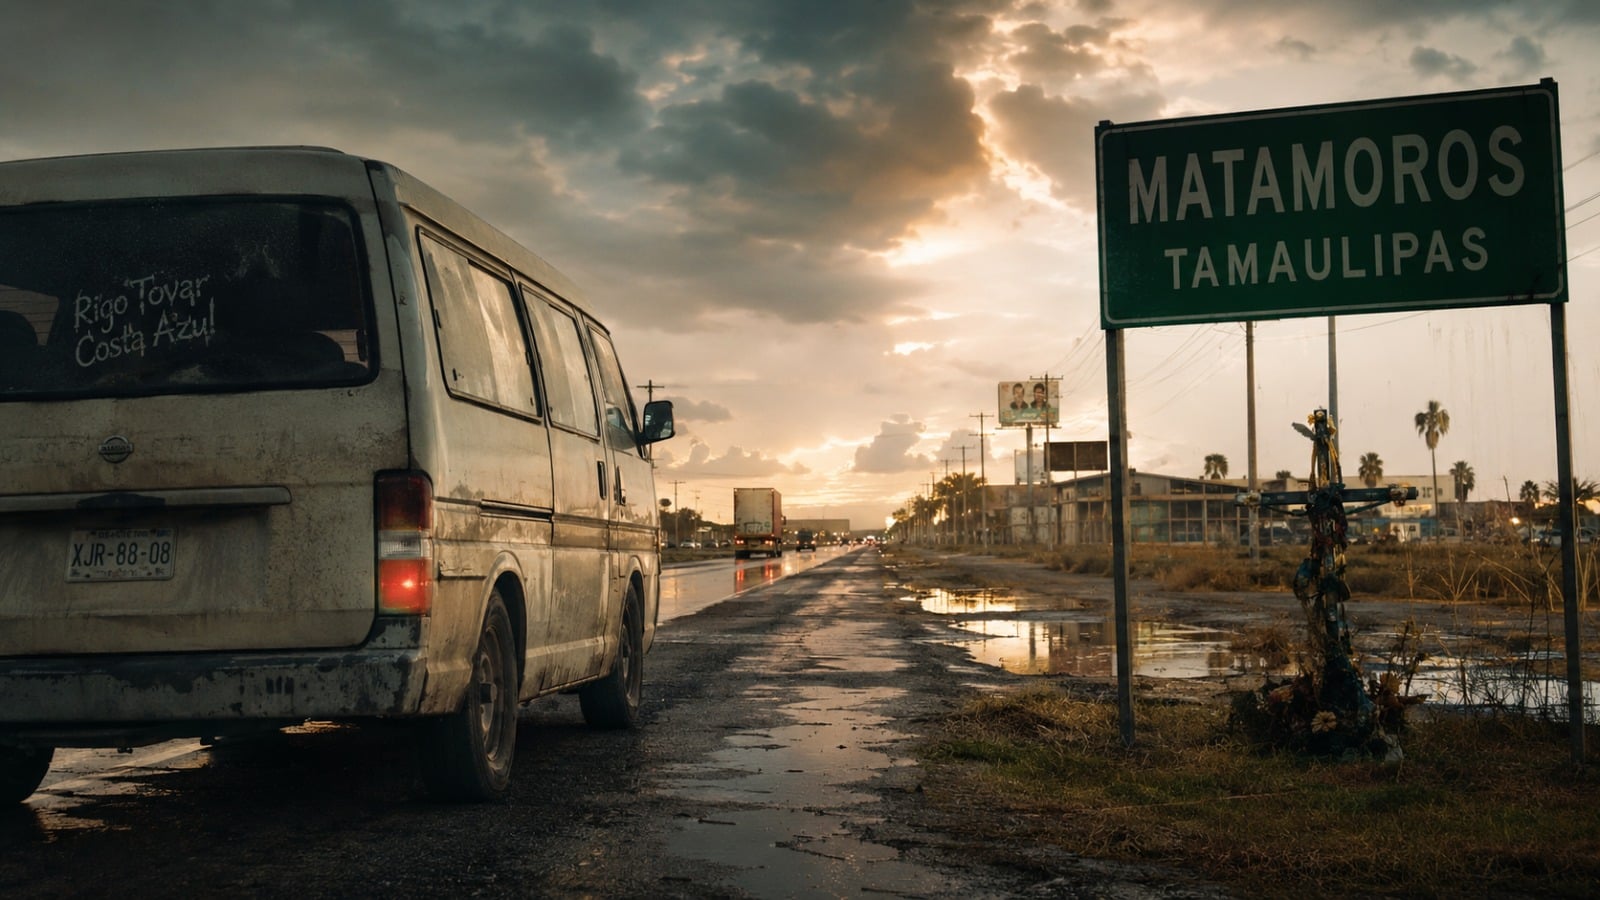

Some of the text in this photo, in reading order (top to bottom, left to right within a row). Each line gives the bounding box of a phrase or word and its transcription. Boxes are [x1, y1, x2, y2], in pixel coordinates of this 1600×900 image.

[1128, 125, 1525, 224] MATAMOROS
[1165, 227, 1488, 290] TAMAULIPAS
[74, 273, 210, 333] Rigo Tovar
[75, 322, 146, 367] Costa
[71, 541, 171, 567] XJR-88-08
